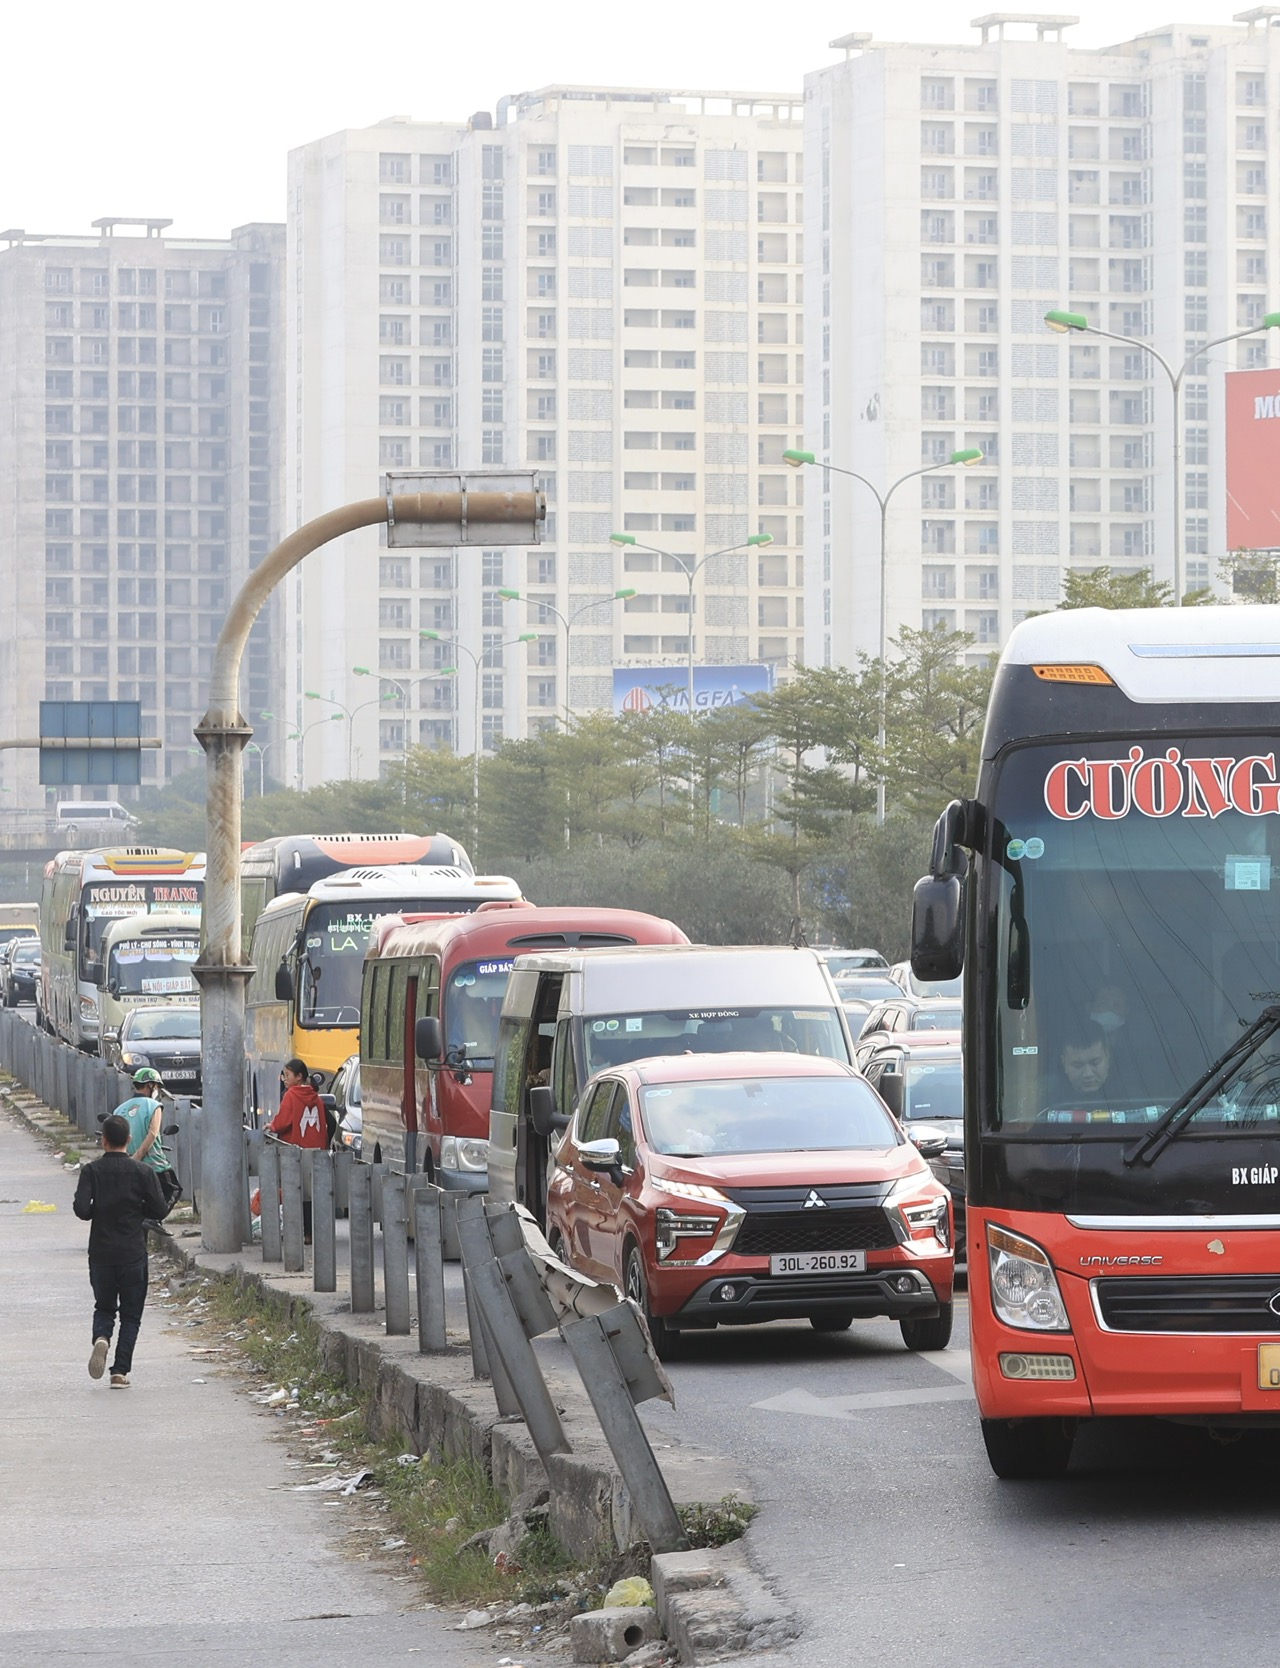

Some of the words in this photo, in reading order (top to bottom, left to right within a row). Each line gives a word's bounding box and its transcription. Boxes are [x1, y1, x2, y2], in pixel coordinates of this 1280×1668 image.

[657, 690, 735, 707] XINGFA
[153, 886, 198, 902] TRANG
[479, 963, 498, 974] GIÁP
[300, 1105, 320, 1138] M
[1232, 1167, 1248, 1185] BX
[1250, 1163, 1279, 1185] GIÁP
[779, 1255, 857, 1272] 30L-260.92
